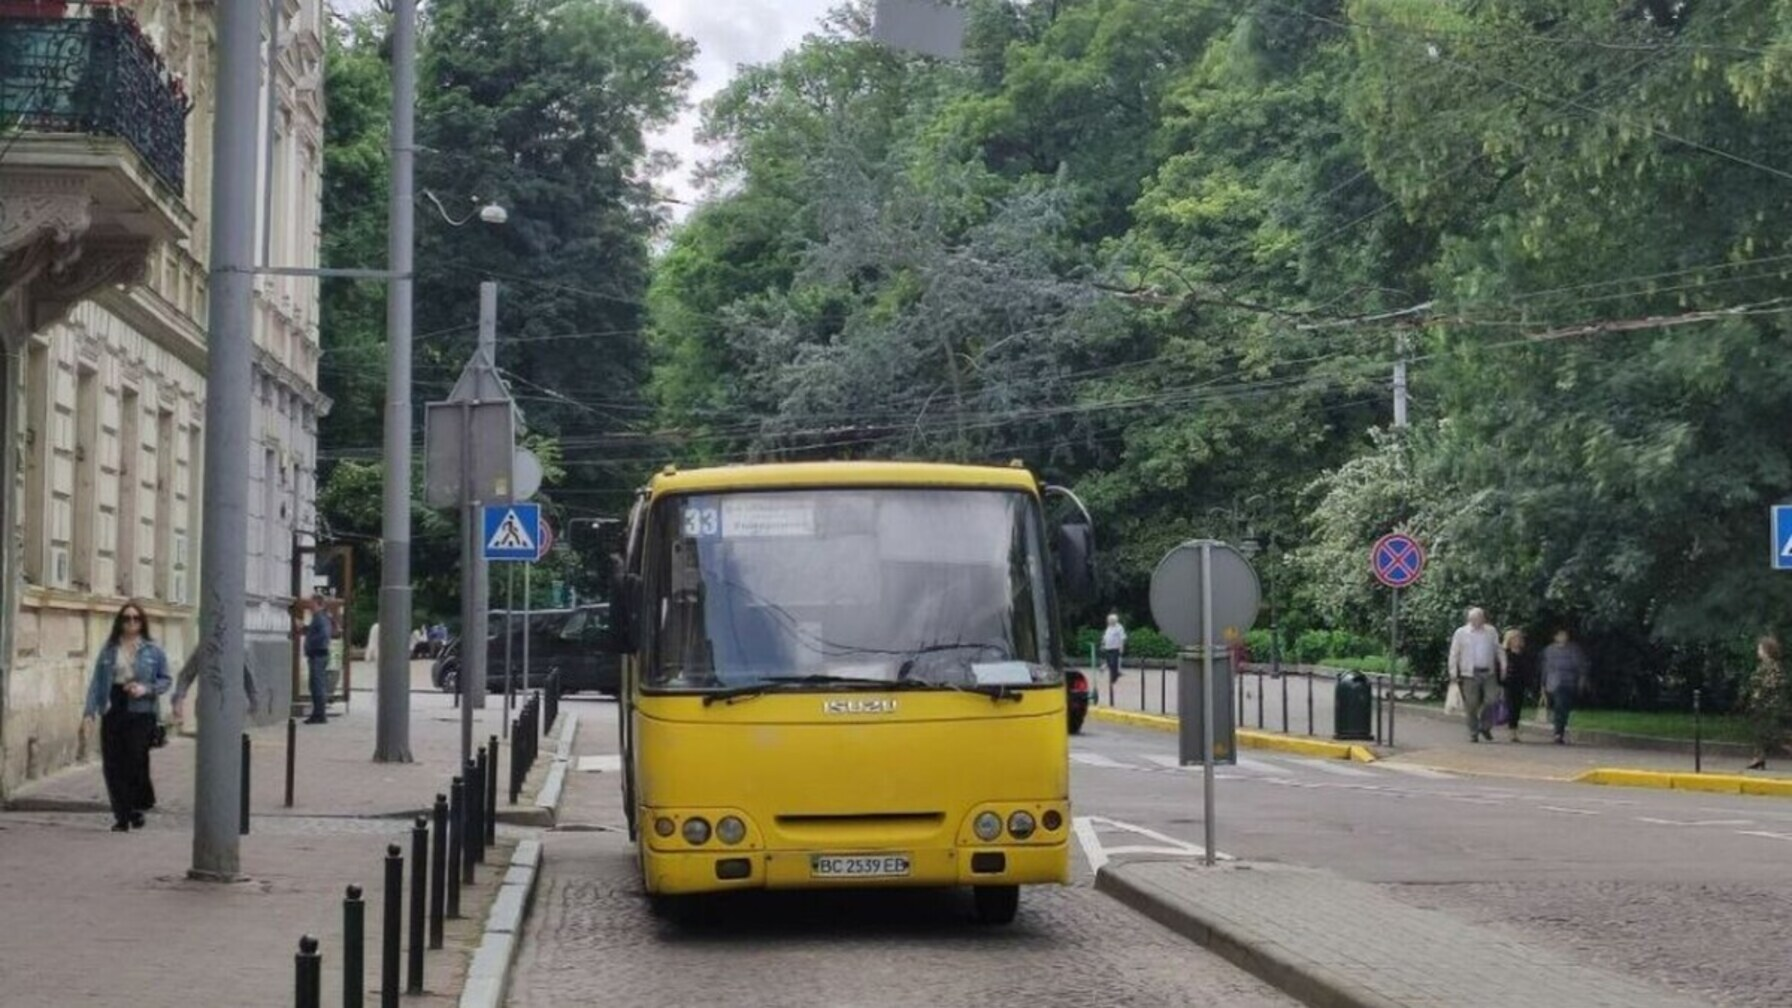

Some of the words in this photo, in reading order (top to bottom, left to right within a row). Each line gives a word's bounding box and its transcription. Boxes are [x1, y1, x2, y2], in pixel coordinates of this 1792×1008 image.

[684, 508, 718, 535] 33
[823, 699, 897, 714] ISUZU
[820, 859, 842, 873] BC
[846, 859, 880, 873] 2539
